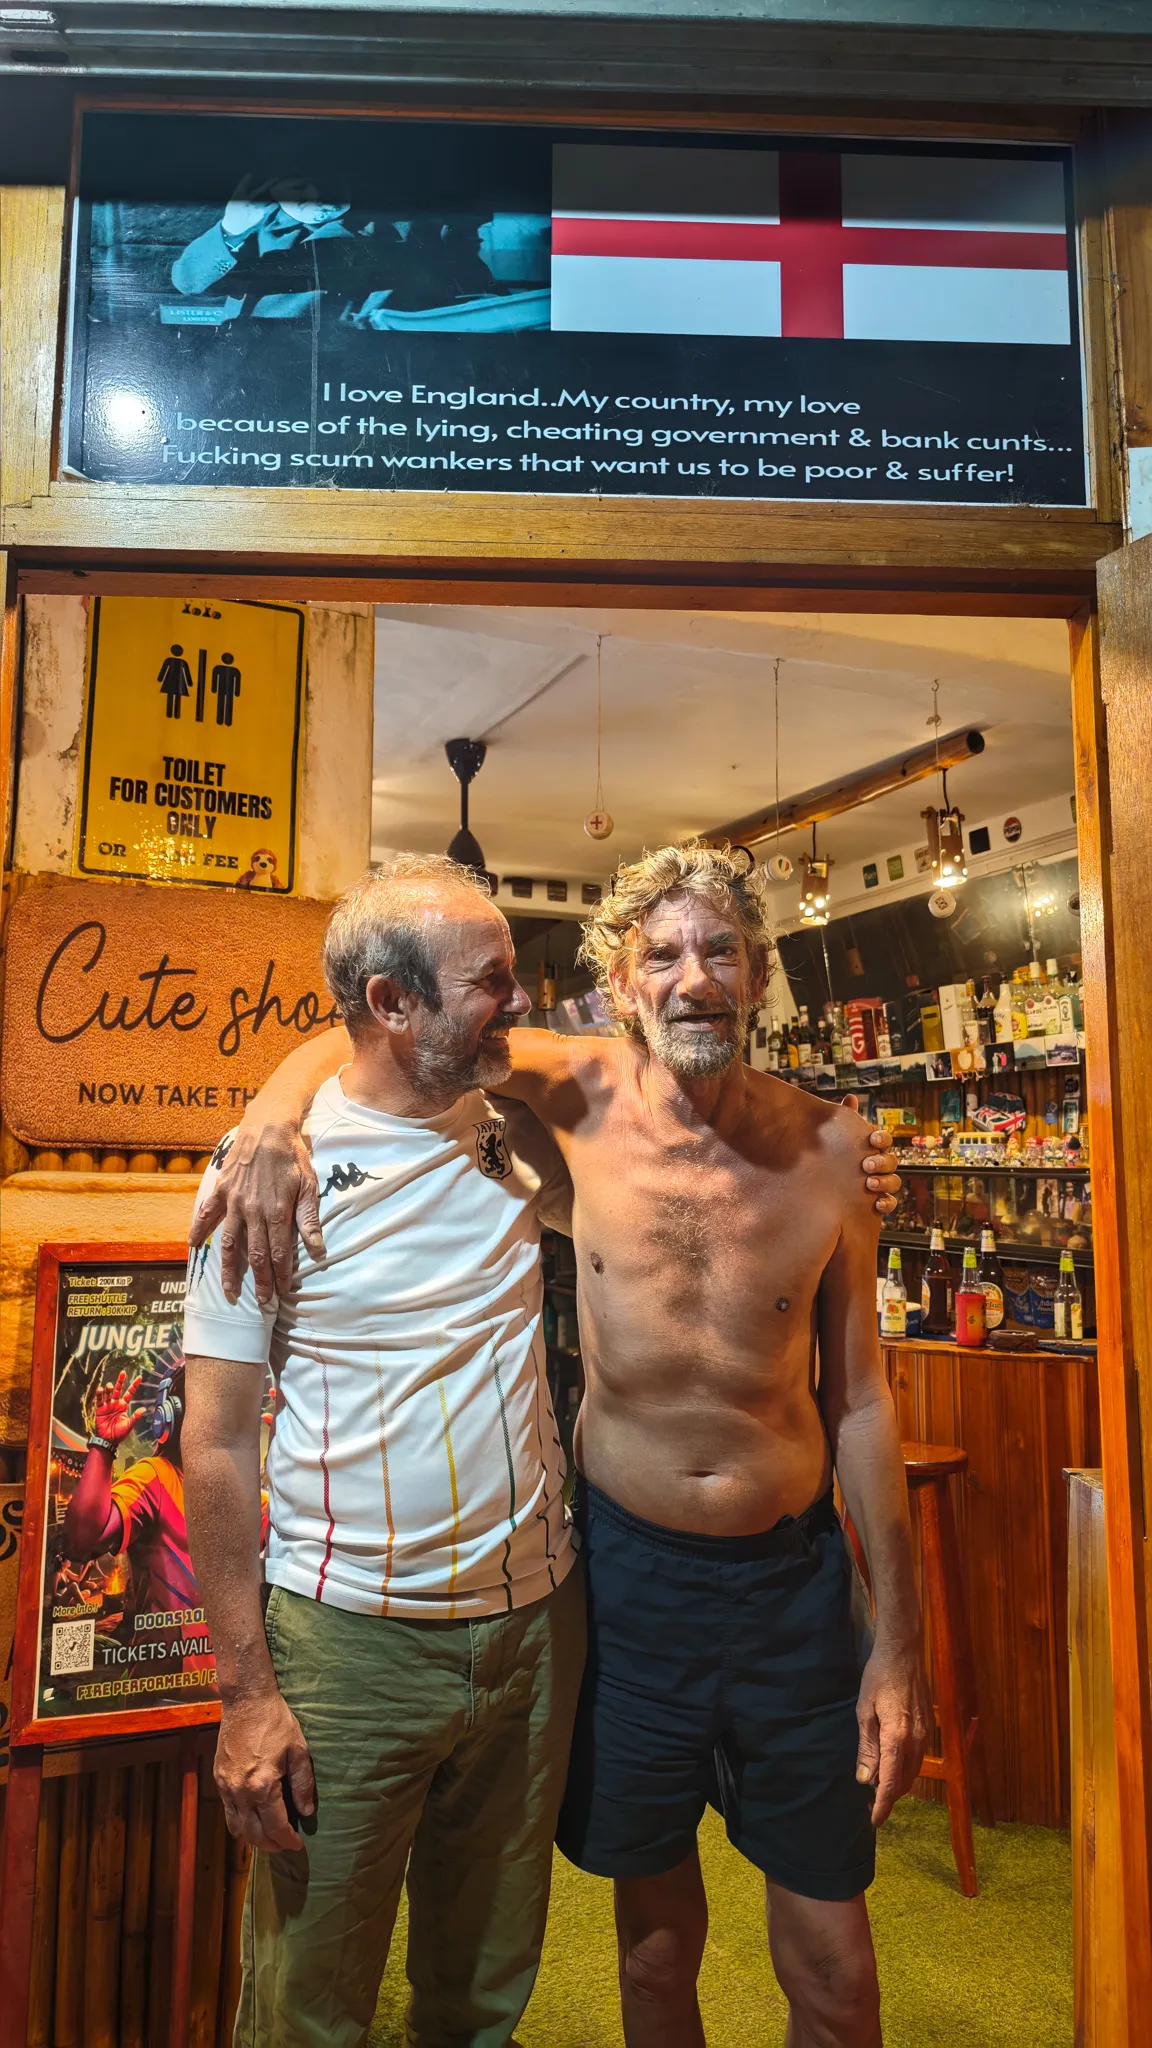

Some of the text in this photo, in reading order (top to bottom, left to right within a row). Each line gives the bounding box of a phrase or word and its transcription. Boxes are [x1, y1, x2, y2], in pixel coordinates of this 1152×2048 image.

[323, 382, 330, 402] I
[339, 382, 403, 403] love
[614, 393, 736, 417] country,
[743, 399, 793, 419] my
[800, 394, 861, 415] love
[176, 412, 1073, 452] because of the lying, cheating government & bank cunts...
[162, 444, 1014, 484] Fucking scum wankers that want us to be poor & suffer!
[162, 756, 226, 787] TOILET
[109, 776, 273, 820] FOR CUSTOMERS
[166, 811, 217, 840] ONLY
[98, 842, 127, 857] OR
[202, 853, 239, 869] FEE
[36, 920, 208, 1044] Cute
[78, 1082, 146, 1105] NOW
[153, 1085, 219, 1108] TAKE
[480, 1120, 506, 1134] AVFC
[67, 1305, 101, 1317] RETURN
[106, 1305, 122, 1316] 30K
[122, 1305, 137, 1316] KIP
[68, 1293, 128, 1305] FREE SHUTTLE
[75, 1324, 173, 1358] JUNGLE
[52, 1605, 75, 1618] More
[135, 1608, 207, 1631] DOORS 10
[102, 1636, 214, 1665] TICKETS AVAIL
[77, 1682, 111, 1701] FIRE
[113, 1671, 200, 1695] PERFORMERS
